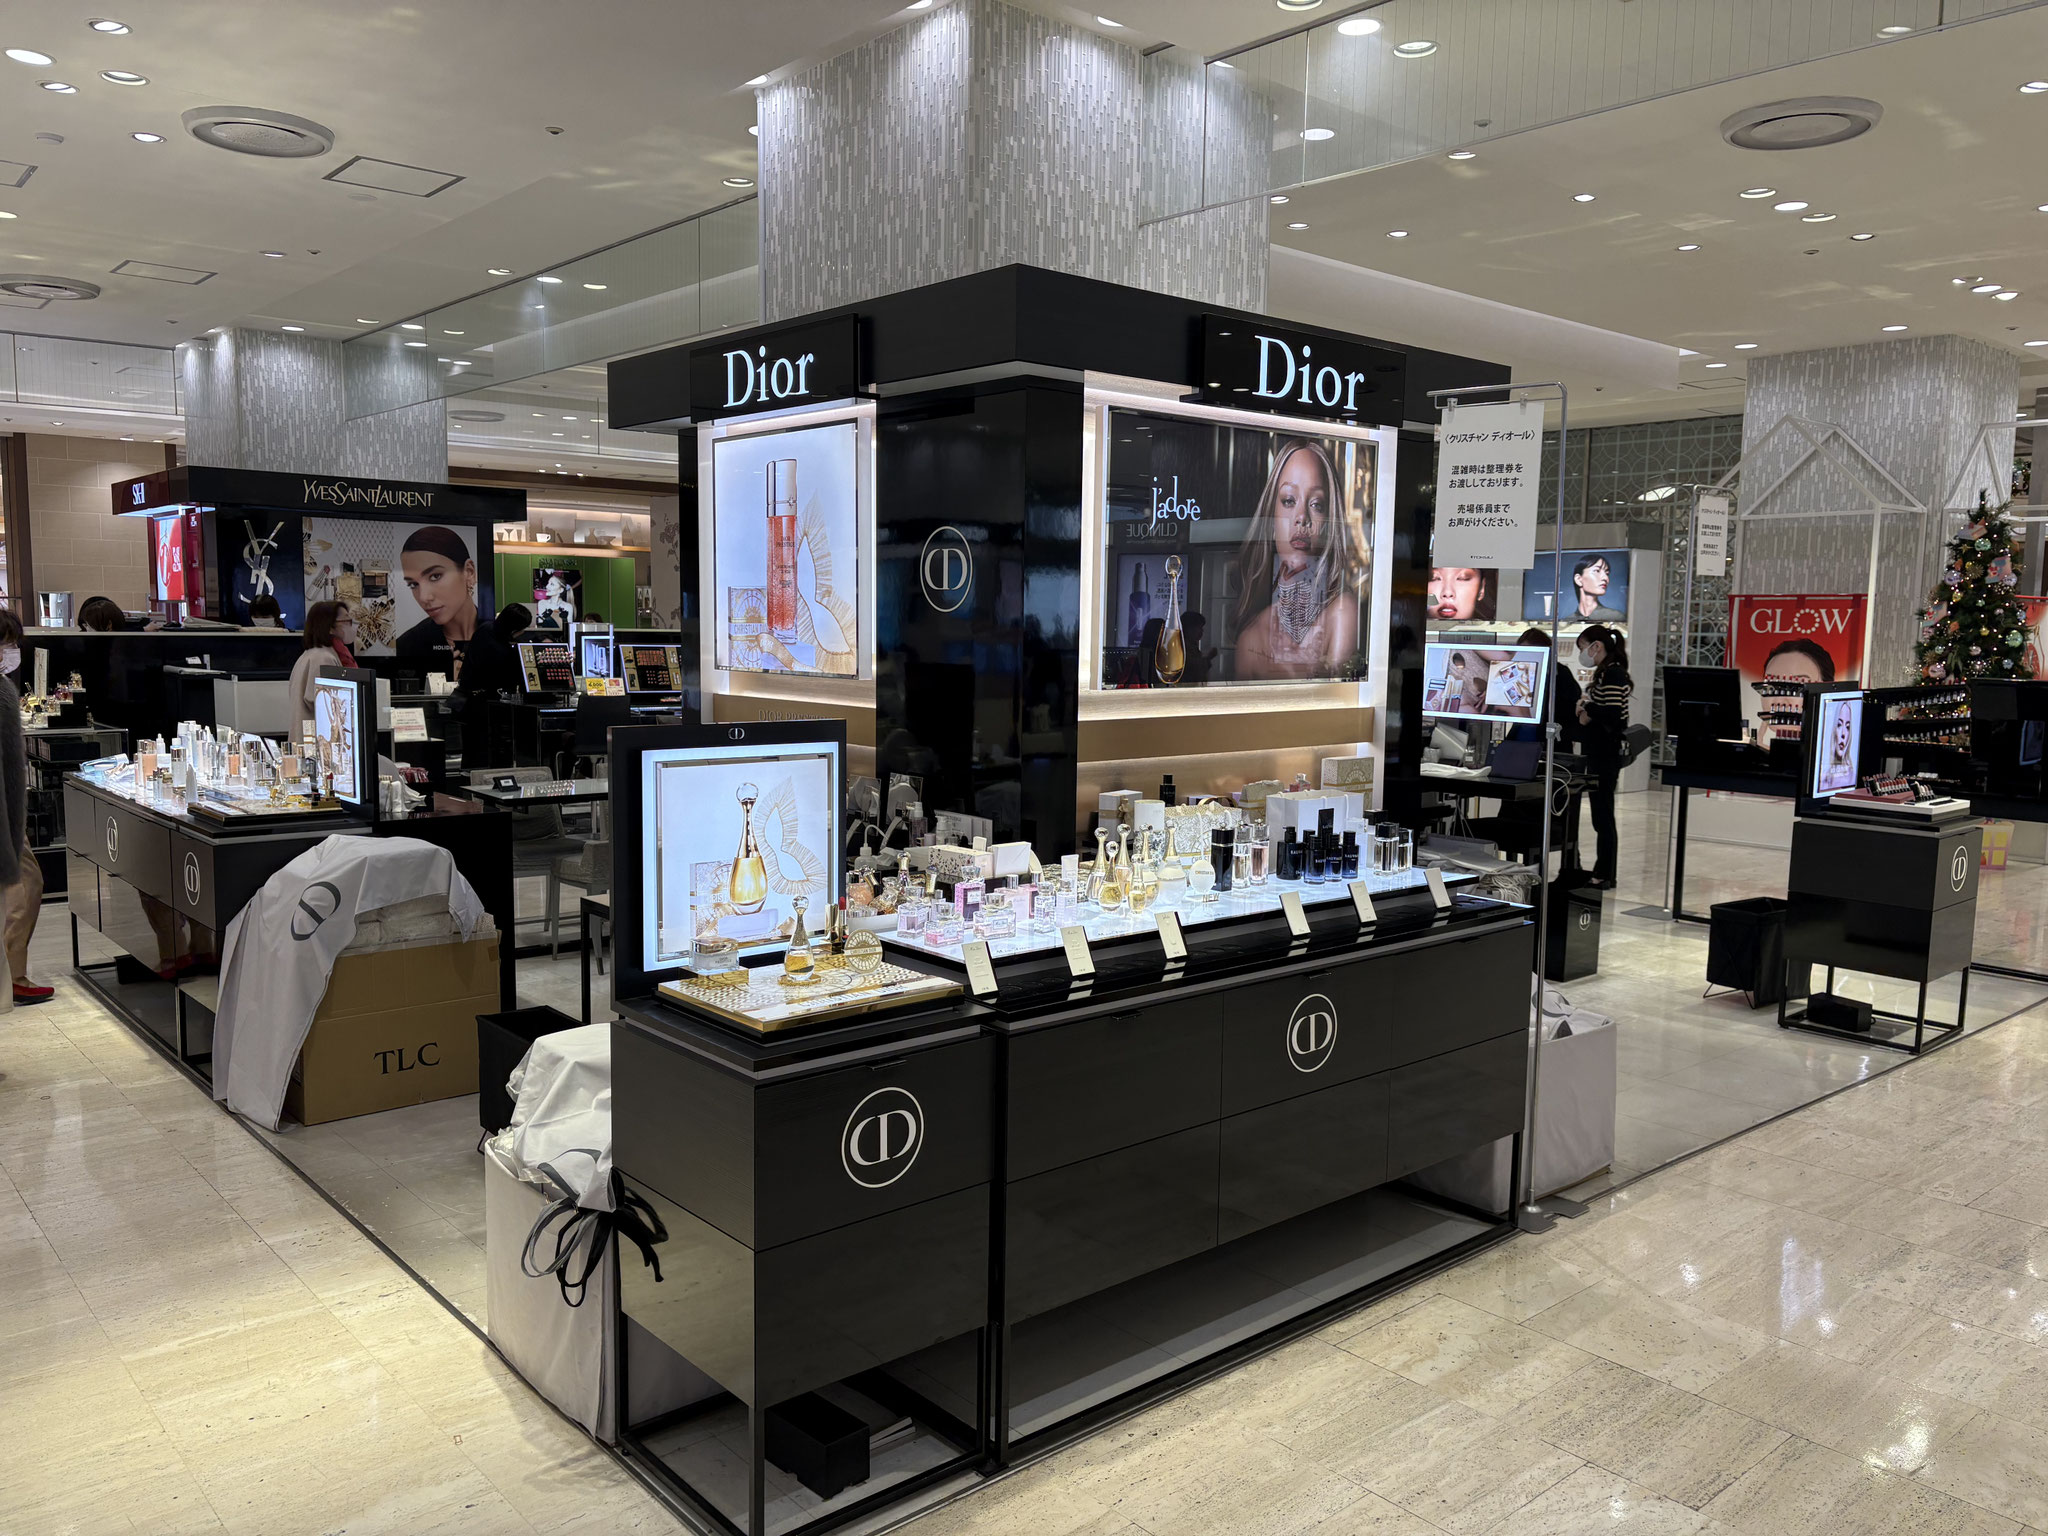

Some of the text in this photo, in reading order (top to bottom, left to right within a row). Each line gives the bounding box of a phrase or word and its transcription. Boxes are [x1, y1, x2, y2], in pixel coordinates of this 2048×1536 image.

[722, 345, 814, 408] Dior
[1252, 335, 1365, 411] Dior
[1451, 463, 1523, 475] 混雑時は整理券を
[1448, 477, 1524, 489] お渡ししております。
[1457, 503, 1511, 514] 売場係員まで
[1448, 517, 1519, 528] お声がけください。
[1750, 608, 1854, 634] GLOW
[373, 1042, 440, 1075] TLC
